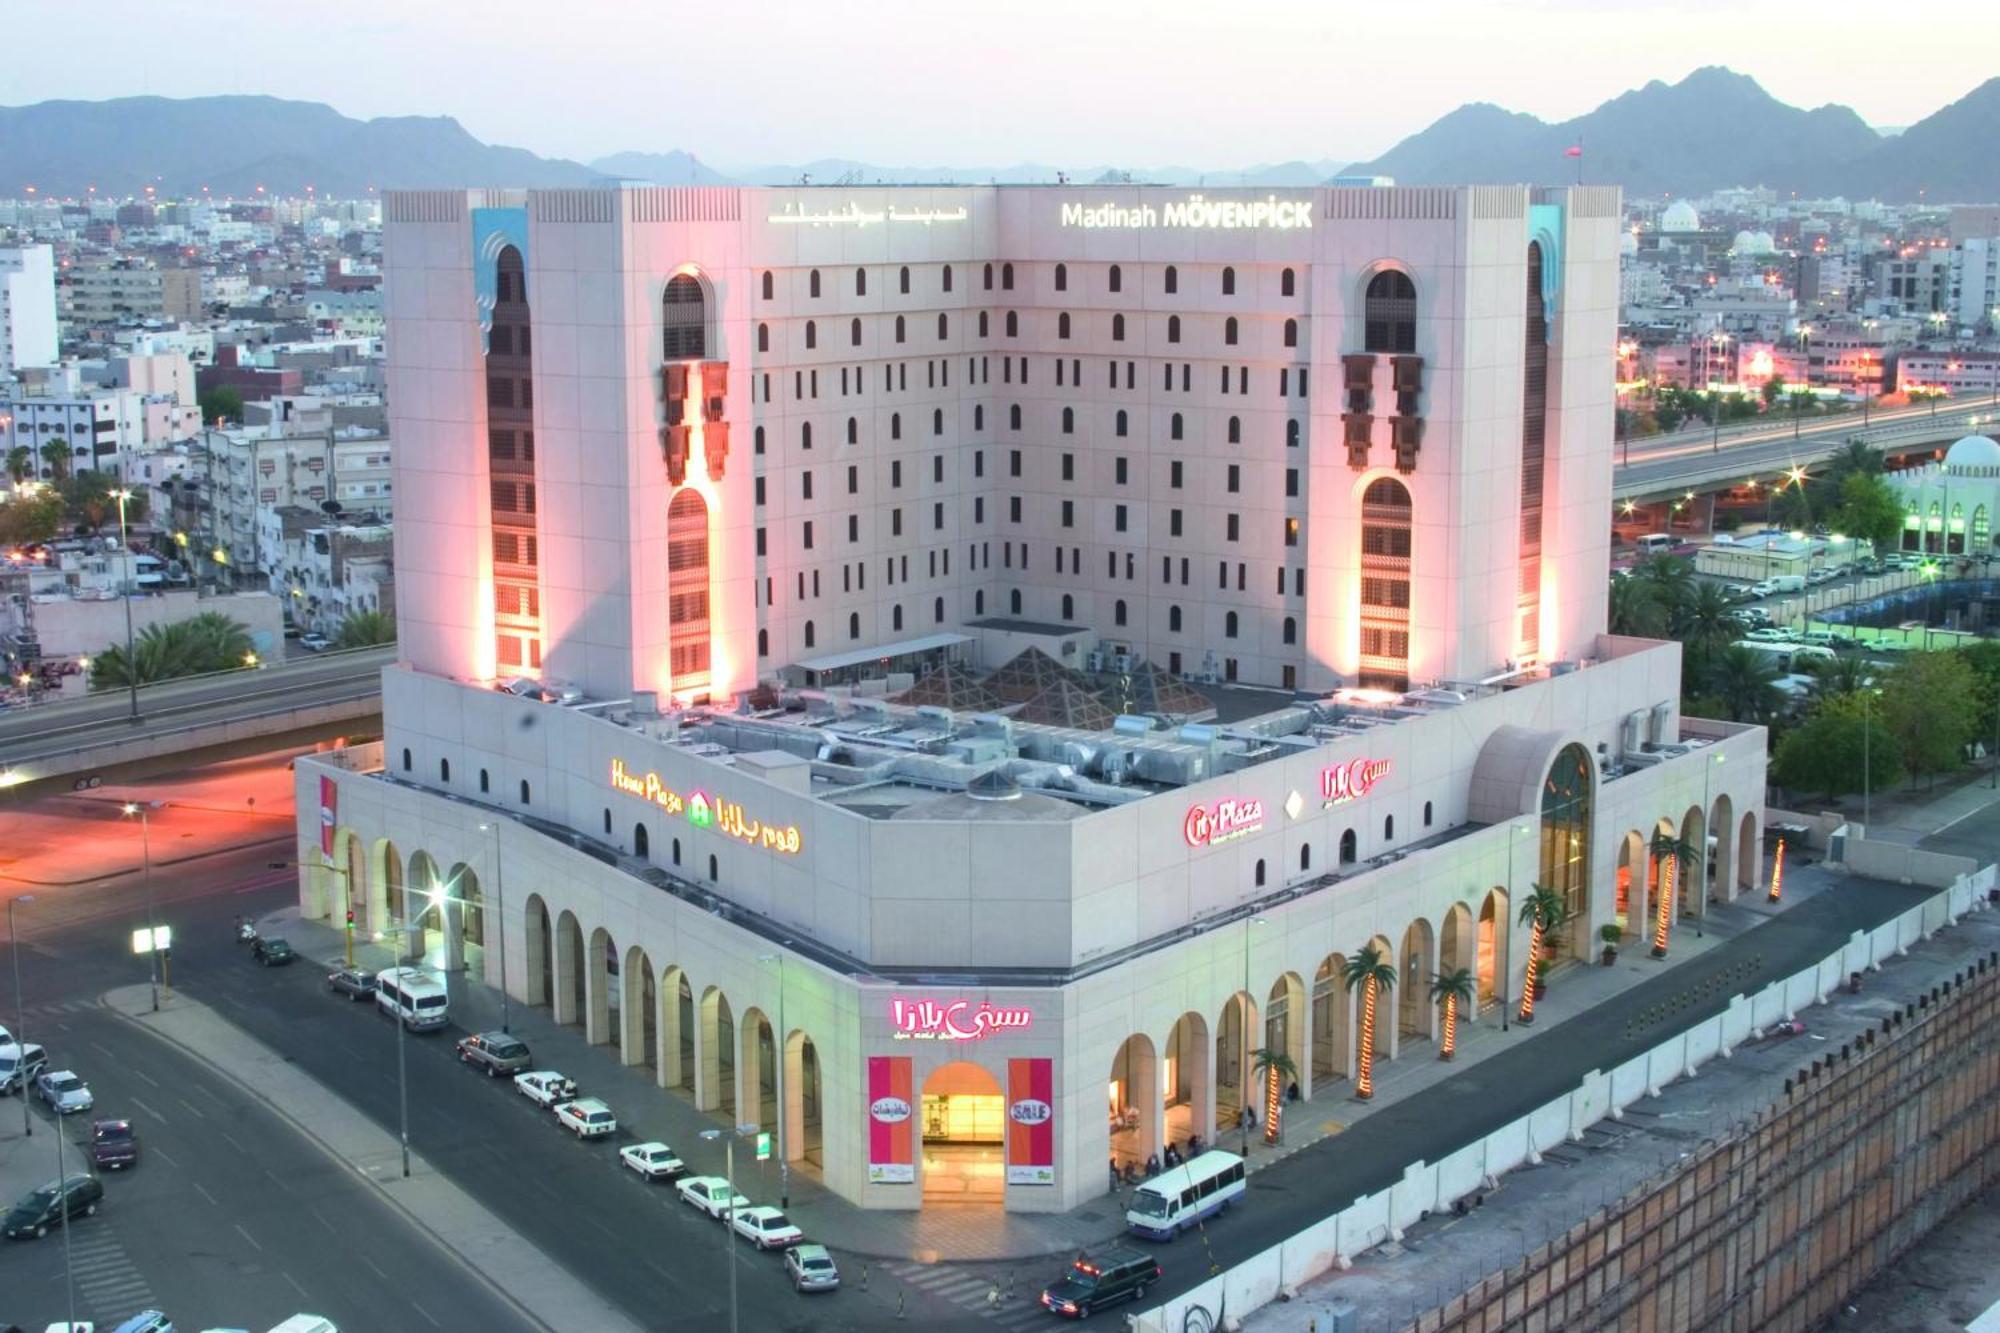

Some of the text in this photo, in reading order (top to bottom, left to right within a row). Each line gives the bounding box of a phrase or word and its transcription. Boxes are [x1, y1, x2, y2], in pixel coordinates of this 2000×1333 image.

[1061, 203, 1156, 227] Madinah
[611, 758, 684, 814] Home Plaza
[716, 797, 760, 844] بلازا
[1184, 805, 1218, 847] City
[1219, 800, 1262, 830] Plaza
[893, 1000, 1030, 1039] سيتي بلازا
